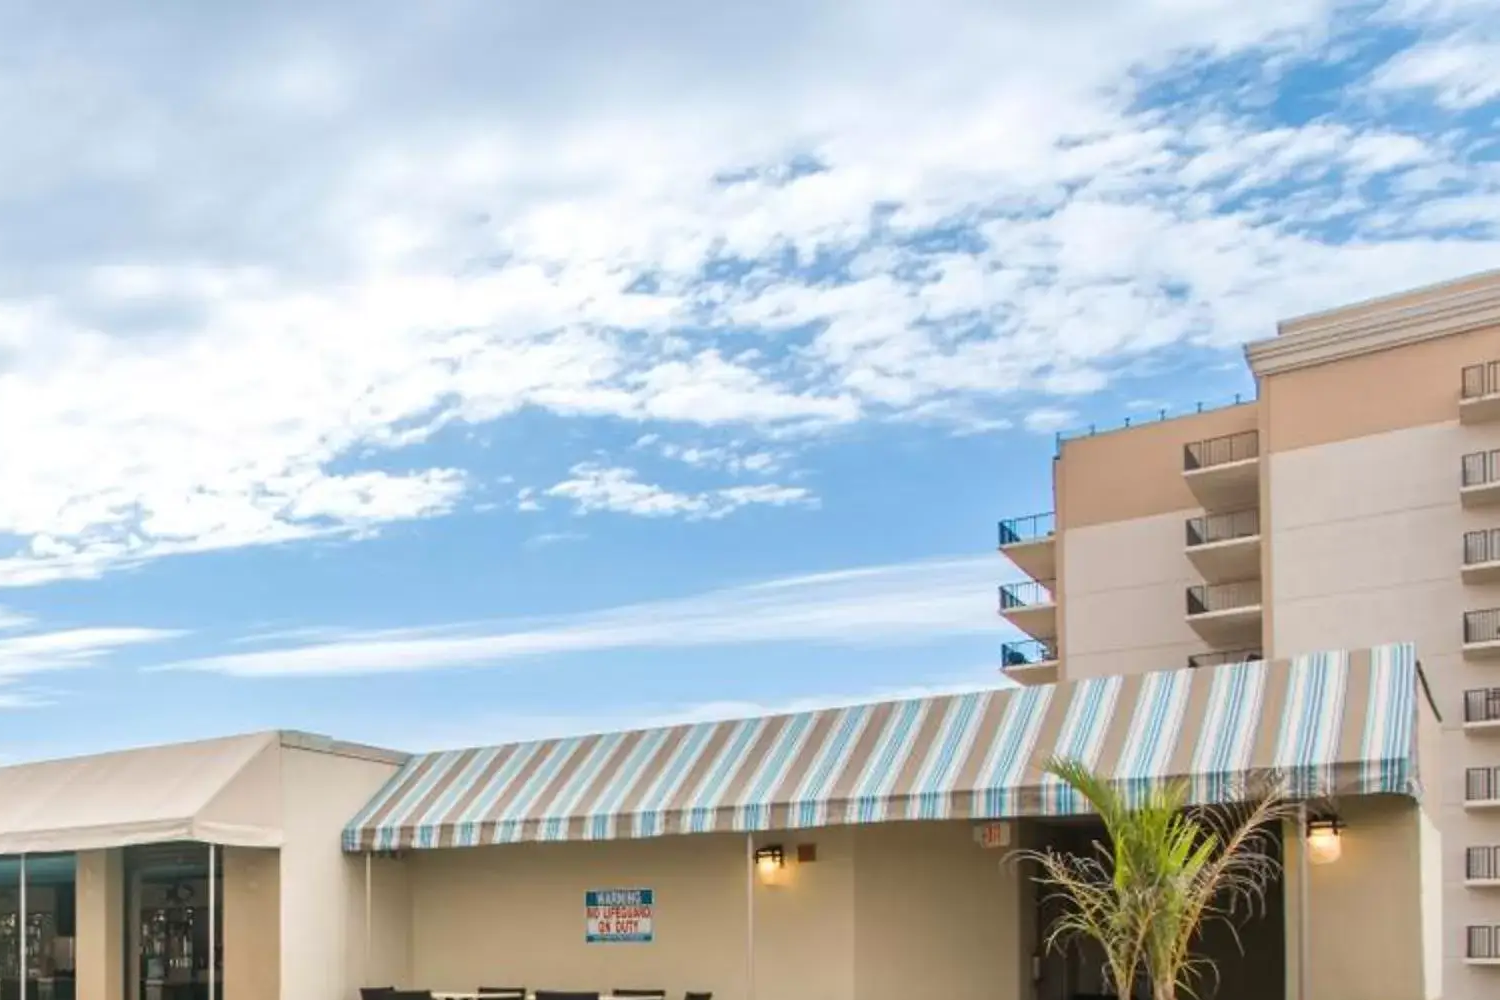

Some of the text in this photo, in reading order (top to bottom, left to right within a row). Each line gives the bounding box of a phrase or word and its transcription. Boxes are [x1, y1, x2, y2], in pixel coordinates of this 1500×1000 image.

[596, 889, 642, 905] WARNING
[586, 906, 652, 919] NO LIFEGUARD
[598, 920, 639, 933] ON DUTY
